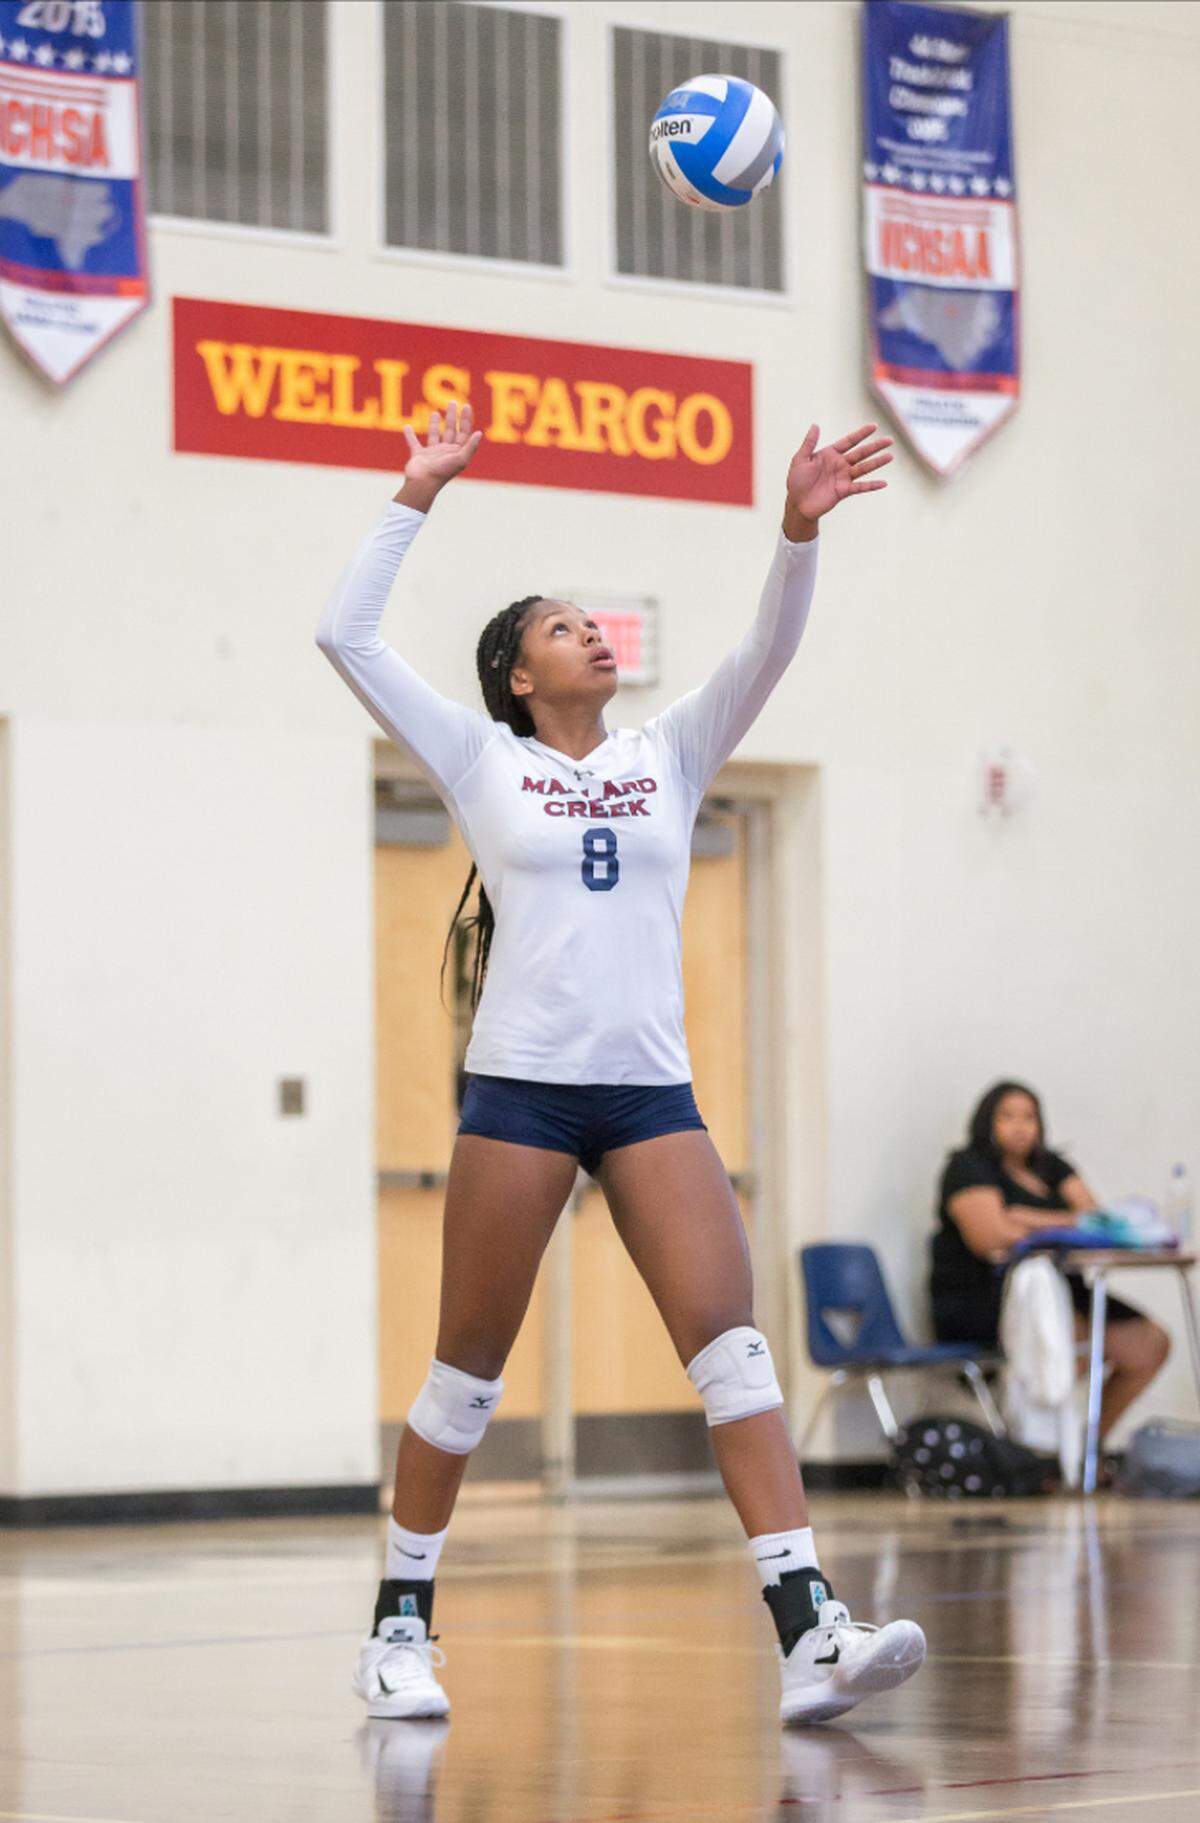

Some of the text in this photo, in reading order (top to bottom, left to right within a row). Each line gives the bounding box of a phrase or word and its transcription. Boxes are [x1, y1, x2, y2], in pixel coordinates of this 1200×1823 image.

[650, 119, 692, 140] olten
[196, 339, 734, 466] WELLS FARGO
[521, 776, 658, 801] MAARD
[543, 798, 652, 819] CREEK
[581, 827, 619, 891] 8
